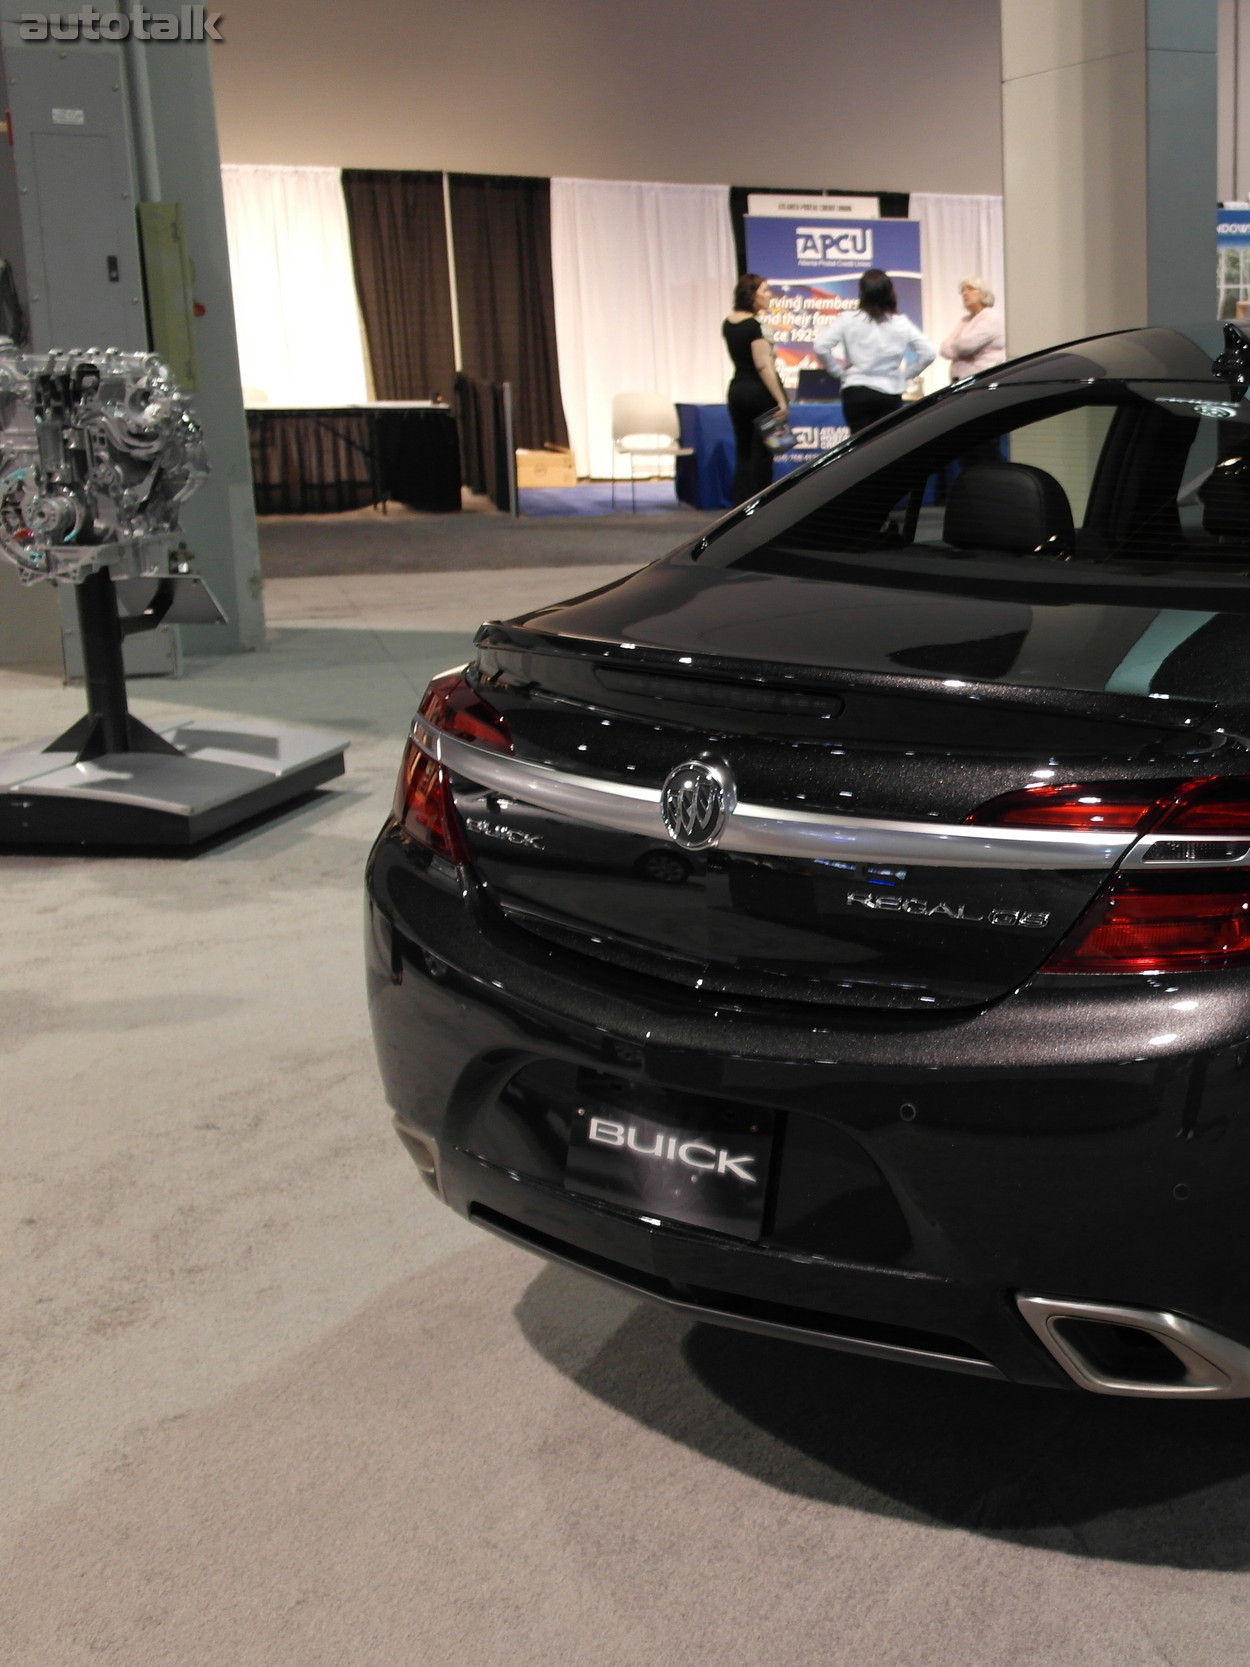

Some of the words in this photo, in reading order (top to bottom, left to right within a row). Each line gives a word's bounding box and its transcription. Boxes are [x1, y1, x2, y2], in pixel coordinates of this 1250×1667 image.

[796, 228, 868, 259] APCU
[769, 296, 802, 311] rving
[803, 296, 860, 310] members
[783, 312, 811, 326] their
[466, 818, 545, 850] BUICK
[847, 892, 984, 921] REGAL
[988, 907, 1051, 929] GS
[588, 1117, 757, 1183] BUICK
